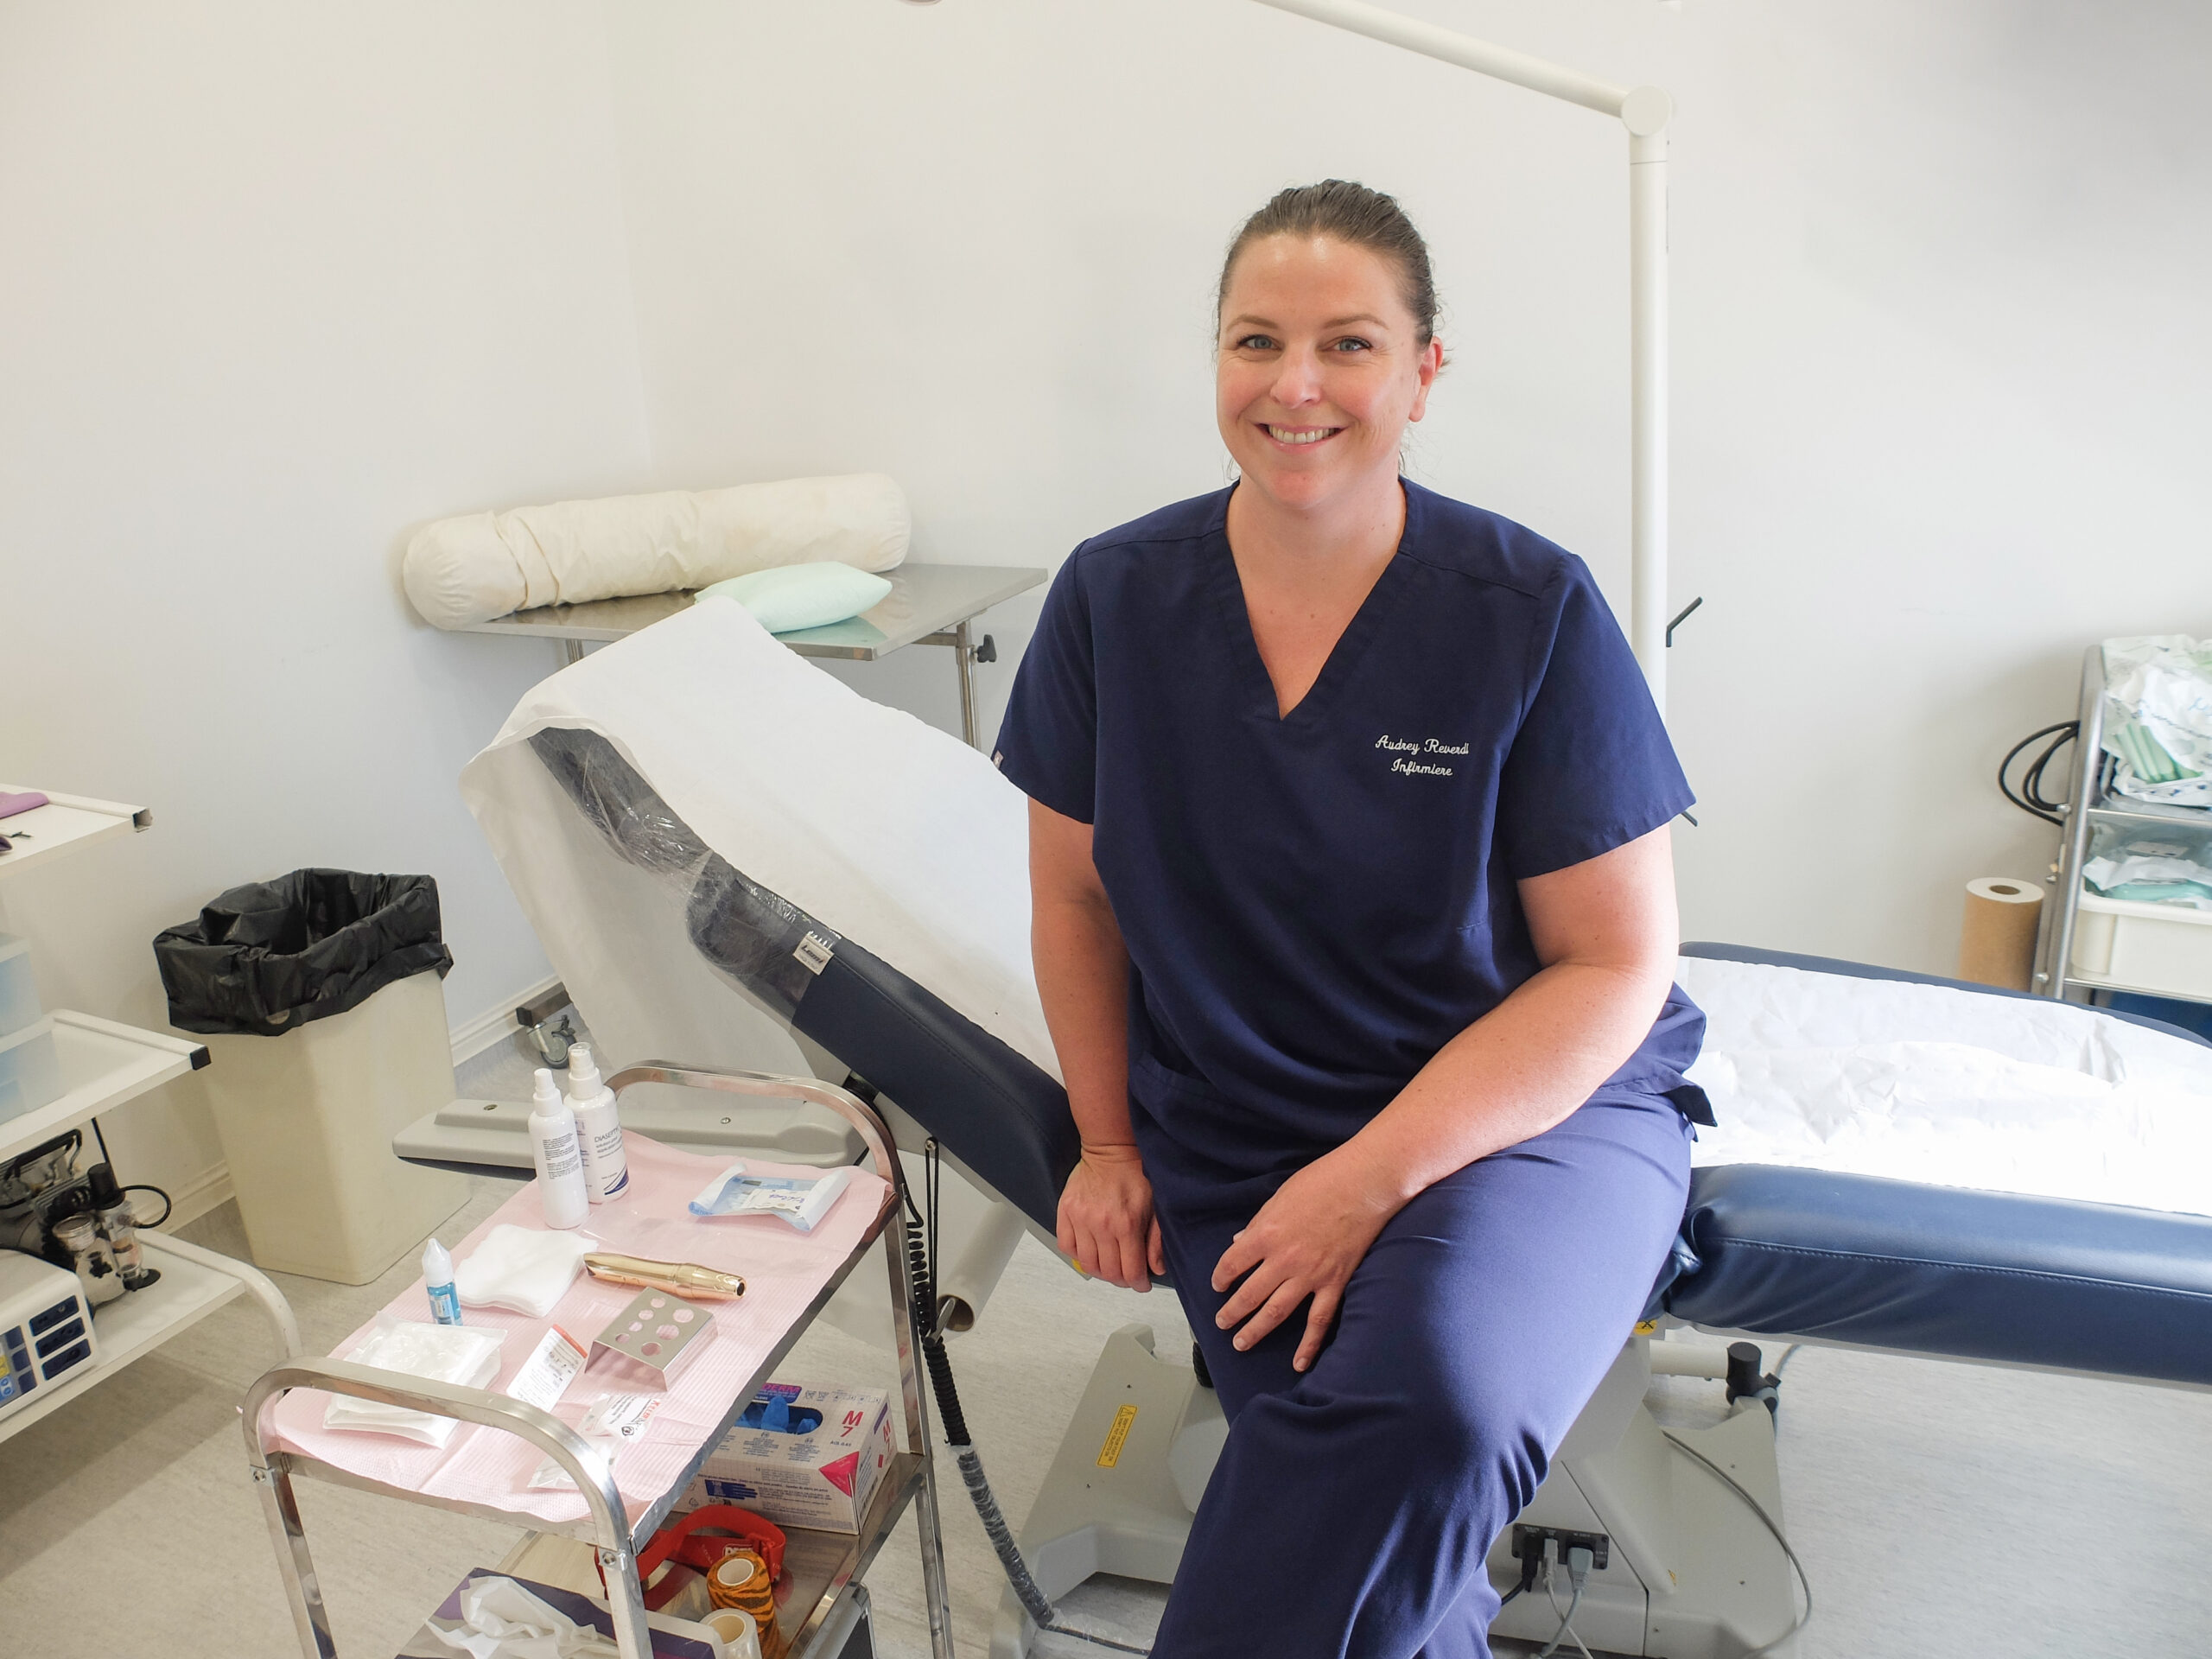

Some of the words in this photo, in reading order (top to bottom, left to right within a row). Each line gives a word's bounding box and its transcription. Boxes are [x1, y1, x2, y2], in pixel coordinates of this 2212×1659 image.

[1375, 734, 1421, 755] Audrey
[1424, 738, 1470, 755] Reverdi
[1391, 758, 1453, 777] Infirmiere
[842, 1409, 864, 1427] M
[840, 1426, 854, 1438] 7
